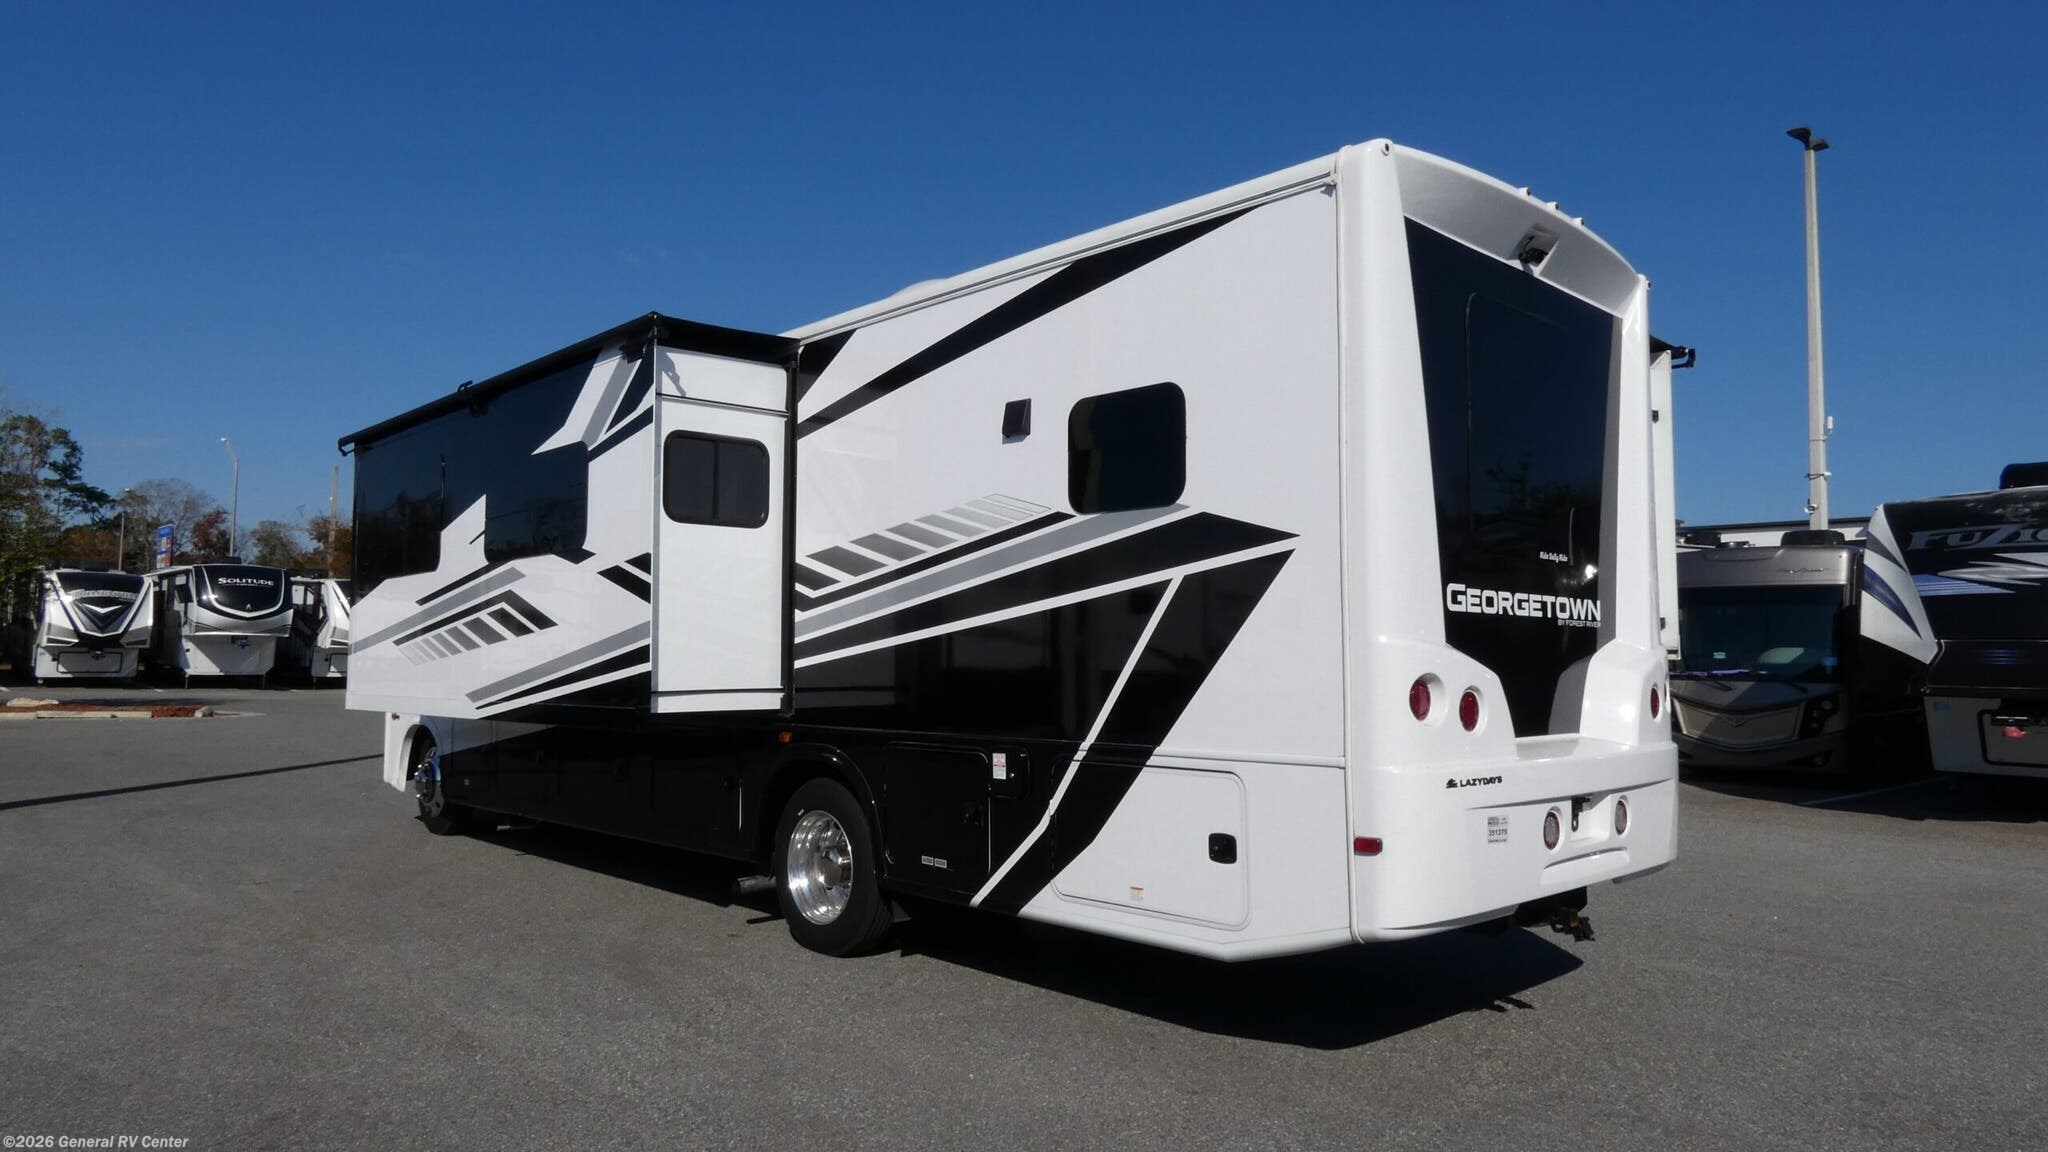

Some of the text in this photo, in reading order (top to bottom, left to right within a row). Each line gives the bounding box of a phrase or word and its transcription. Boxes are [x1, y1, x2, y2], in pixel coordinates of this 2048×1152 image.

[218, 577, 275, 586] SOLITUDE
[1446, 583, 1600, 621] GEORGETOWN
[1565, 619, 1586, 628] FOREST
[1460, 776, 1502, 787] LAZYDAYS
